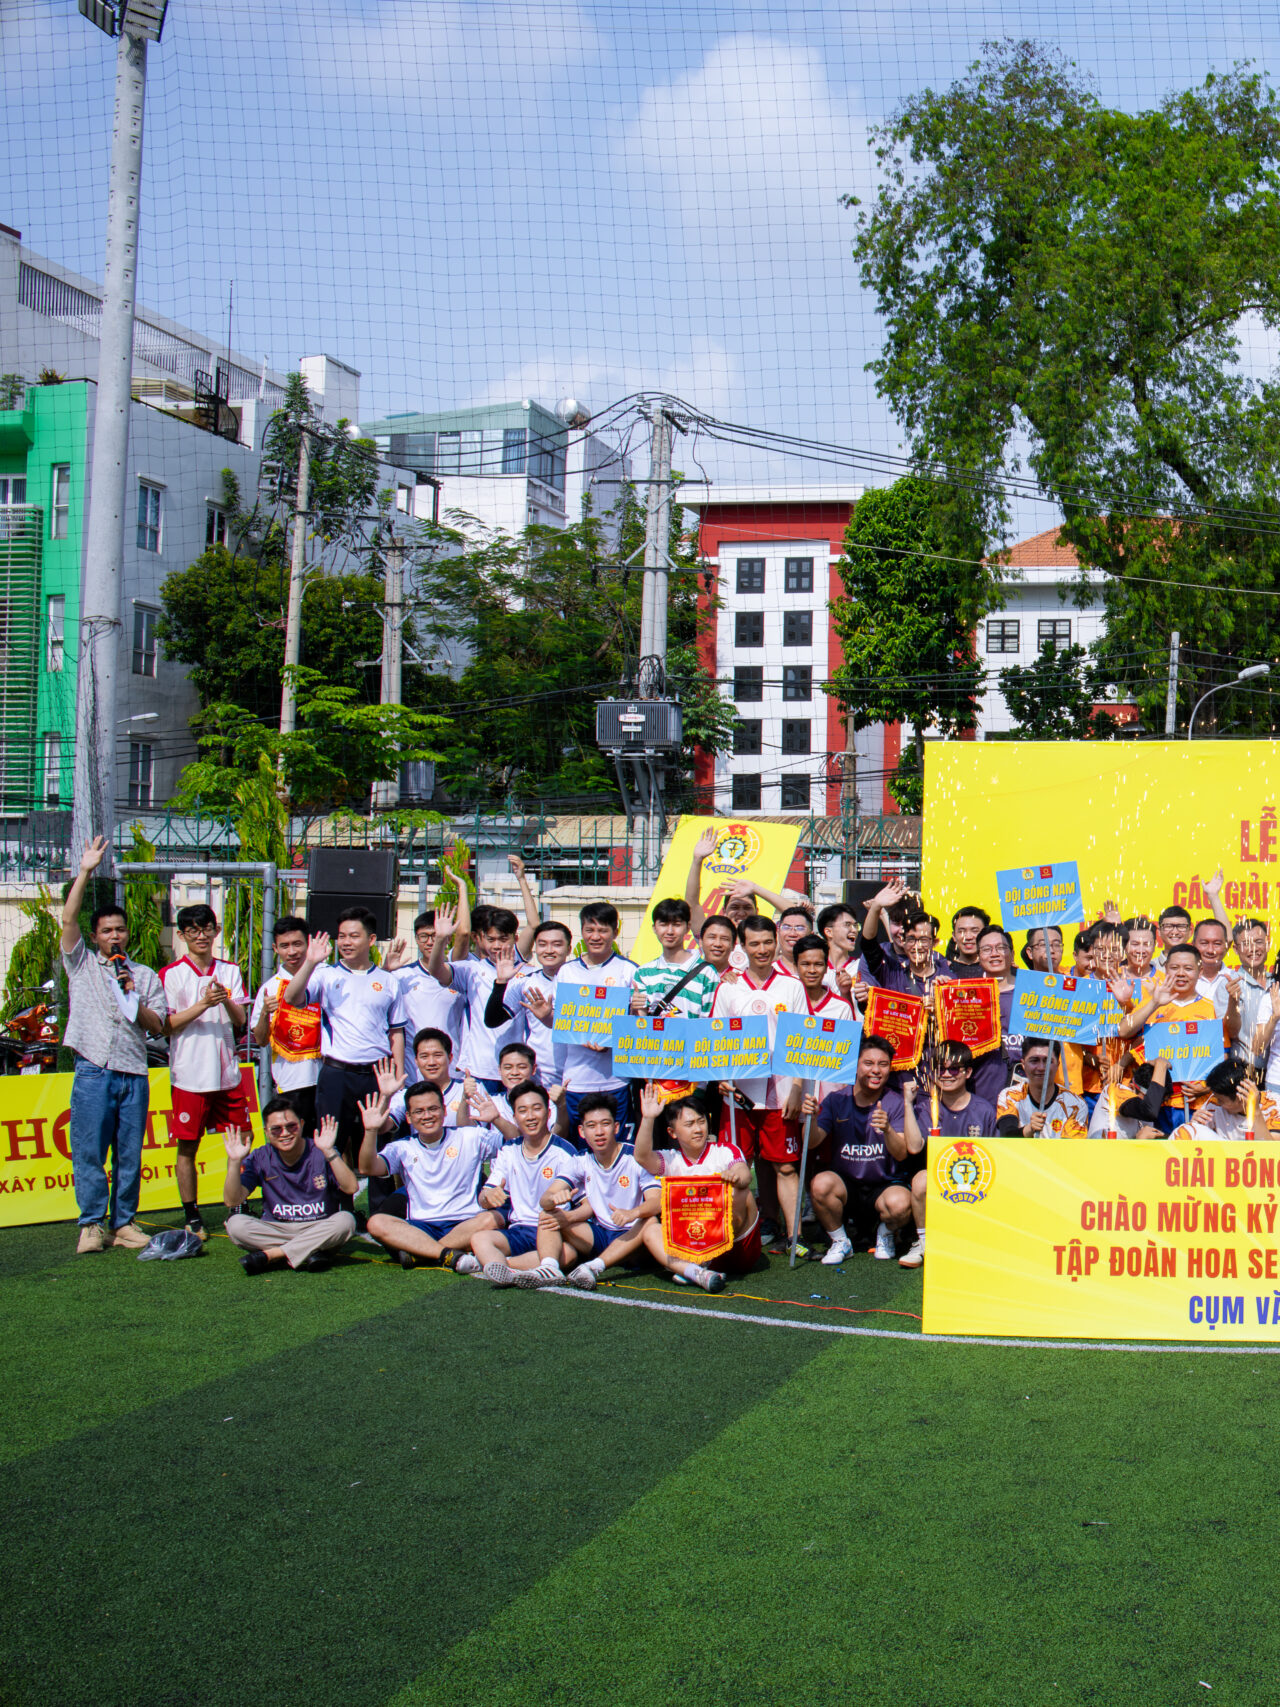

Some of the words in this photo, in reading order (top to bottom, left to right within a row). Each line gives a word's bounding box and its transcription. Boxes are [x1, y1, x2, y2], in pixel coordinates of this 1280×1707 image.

[1241, 807, 1278, 862] LỄ
[1005, 886, 1021, 903] ĐỘI
[1024, 884, 1051, 901] BÓNG
[1053, 881, 1075, 897] NAM
[1225, 873, 1268, 909] GIẢI
[1013, 899, 1067, 917] DASHHOME
[561, 1003, 575, 1018] ĐỘI
[578, 1003, 598, 1018] BÓNG
[600, 1006, 625, 1020] NAM
[1020, 991, 1039, 1007] ĐỘI
[1041, 994, 1068, 1010] BÓNG
[1070, 998, 1098, 1015] NAM
[554, 1018, 572, 1031] HOA
[573, 1019, 590, 1033] SEN
[592, 1021, 612, 1035] HOM
[1041, 1012, 1082, 1026] MARKETING
[618, 1037, 634, 1053] ĐỘI
[636, 1036, 660, 1051] BÓNG
[662, 1039, 684, 1052] NAM
[695, 1038, 711, 1054] ĐỘI
[714, 1036, 740, 1052] BÓNG
[743, 1036, 766, 1050] NAM
[786, 1033, 802, 1050] ĐỘI
[805, 1036, 832, 1052] BÓNG
[835, 1039, 851, 1054] NỮ
[1176, 1046, 1190, 1060] CỜ
[1192, 1046, 1211, 1059] VUA
[690, 1055, 709, 1068] HOA
[711, 1054, 730, 1068] SEN
[731, 1052, 760, 1067] HOME
[761, 1052, 768, 1065] 2
[786, 1051, 842, 1070] DASHHOME
[1166, 1148, 1214, 1188] GIẢI
[0, 1176, 36, 1195] XÂY
[45, 1170, 76, 1193] DỰ
[140, 1164, 159, 1181] ỘI
[273, 1202, 325, 1217] ARROW
[1081, 1194, 1147, 1232] CHÀO
[1158, 1194, 1237, 1234] MỪNG
[1248, 1194, 1278, 1234] KỶ
[1054, 1239, 1100, 1282] TẬP
[1109, 1240, 1177, 1278] ĐOÀN
[1188, 1248, 1238, 1279] HOA
[1190, 1296, 1244, 1331] CỤM
